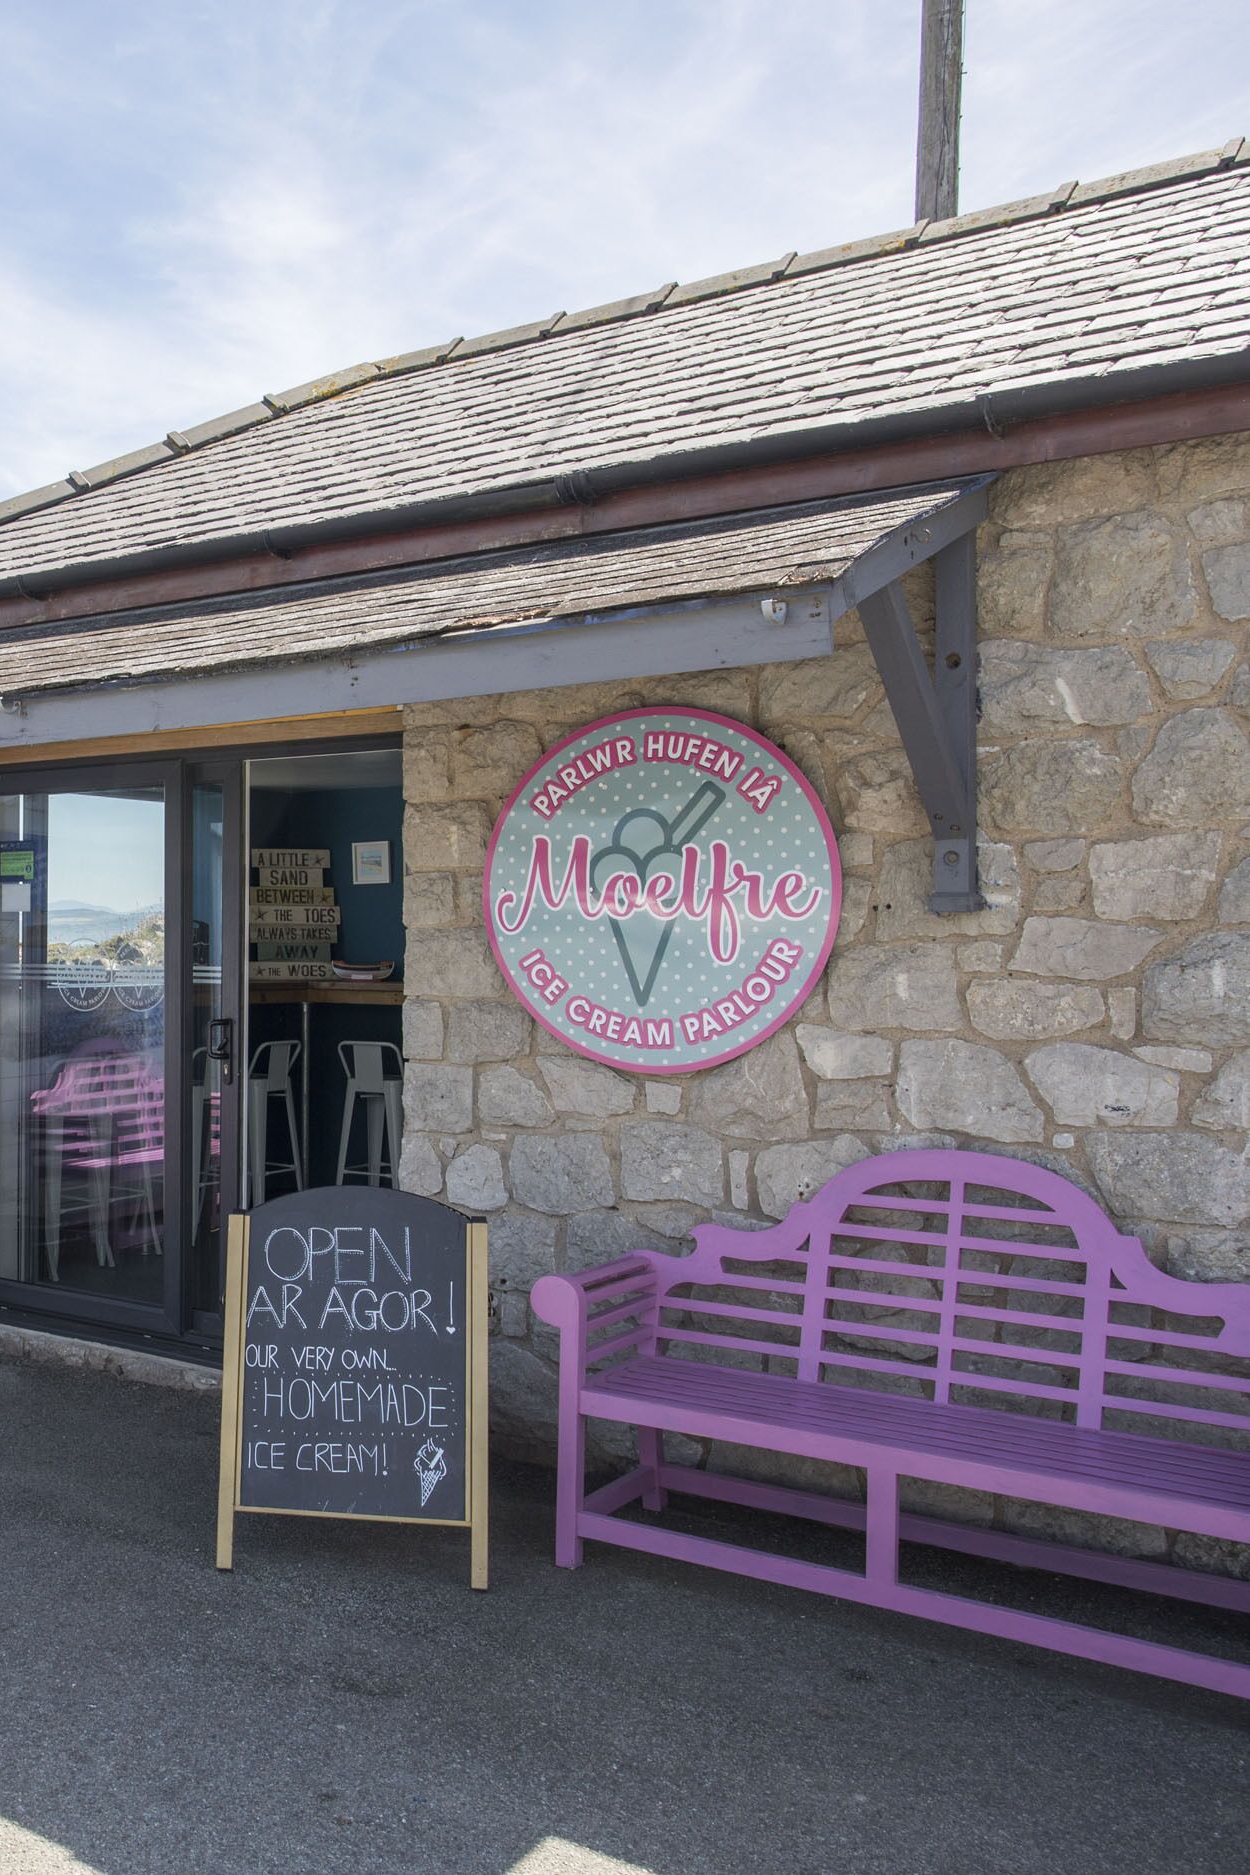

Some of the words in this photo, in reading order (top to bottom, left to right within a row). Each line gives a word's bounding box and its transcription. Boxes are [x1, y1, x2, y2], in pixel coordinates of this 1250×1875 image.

[533, 738, 634, 816] PARLWR
[646, 735, 739, 778] HUFEN
[740, 772, 779, 810] IÂ
[257, 852, 266, 867] A
[269, 852, 310, 867] LITTLE
[269, 869, 309, 886] SAND
[256, 888, 315, 904] BETWEEN
[496, 834, 823, 963] Moelfre
[273, 908, 293, 921] THE
[304, 908, 336, 924] TOES
[256, 927, 298, 940] ALWAYS
[300, 927, 331, 940] TAKES
[275, 945, 318, 960] AWAY
[268, 967, 281, 977] THE
[288, 964, 327, 977] WOES
[521, 951, 566, 1002] ICE
[568, 1000, 671, 1046] CREAM
[685, 941, 799, 1041] PARLOUR
[264, 1226, 412, 1286] OPEN
[246, 1283, 307, 1329] AR
[245, 1344, 279, 1368] OUR
[291, 1346, 334, 1371] VERY
[264, 1377, 448, 1427] HOMEMADE
[248, 1441, 286, 1470] ICE
[295, 1442, 389, 1477] CREAM!
